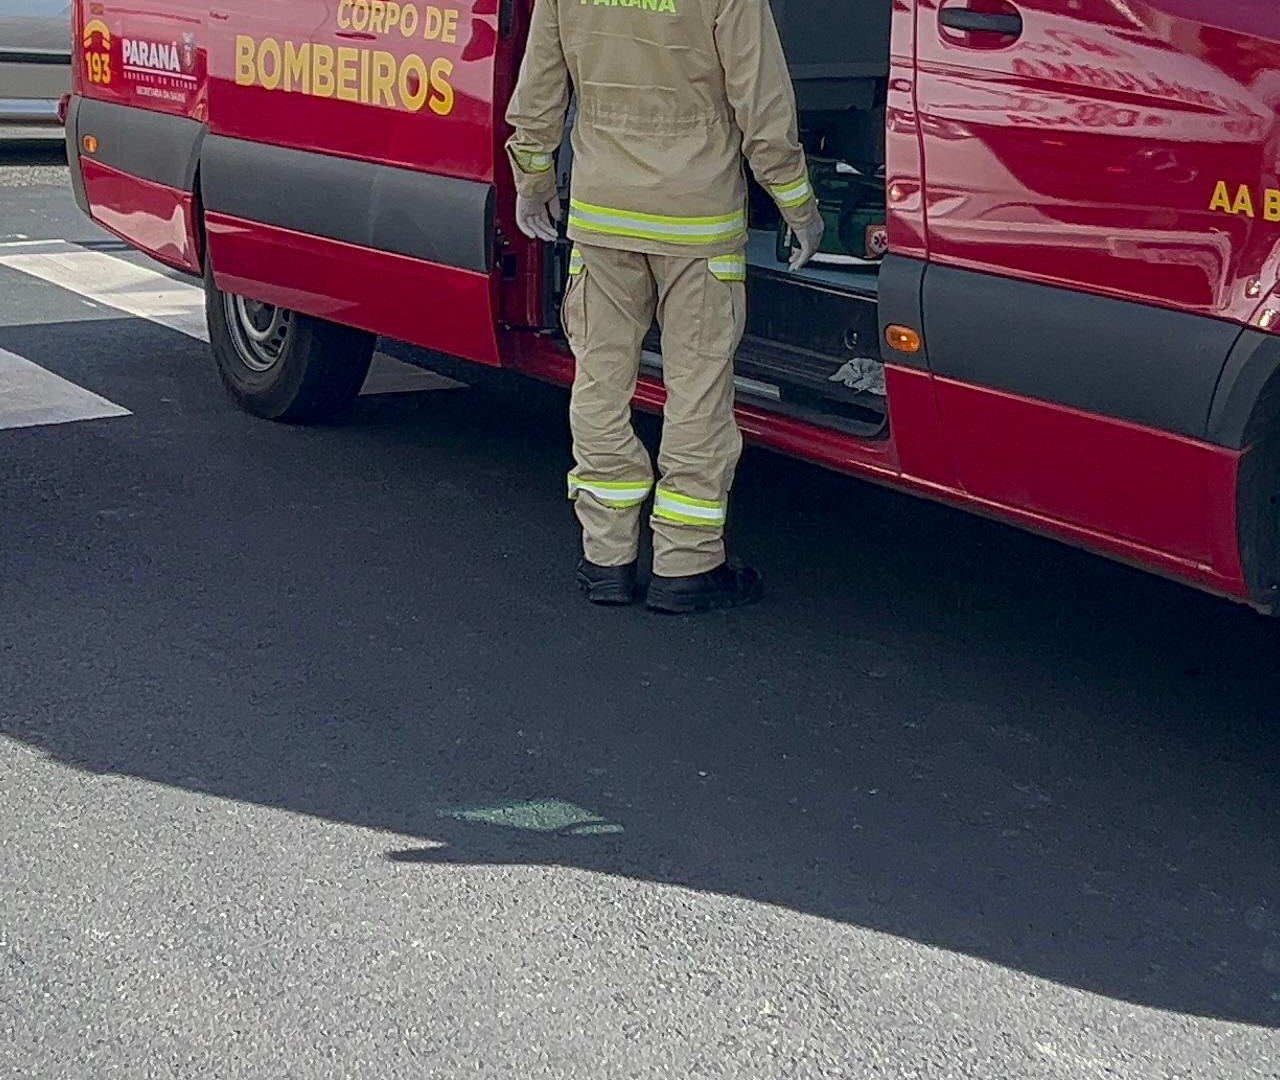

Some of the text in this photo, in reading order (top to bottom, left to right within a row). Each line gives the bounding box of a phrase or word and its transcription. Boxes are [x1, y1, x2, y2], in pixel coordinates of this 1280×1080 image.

[423, 5, 459, 44] DE
[84, 51, 112, 84] 193
[121, 38, 181, 72] PARANÁ
[234, 33, 455, 116] BOMBEIROS
[1208, 180, 1255, 218] AA
